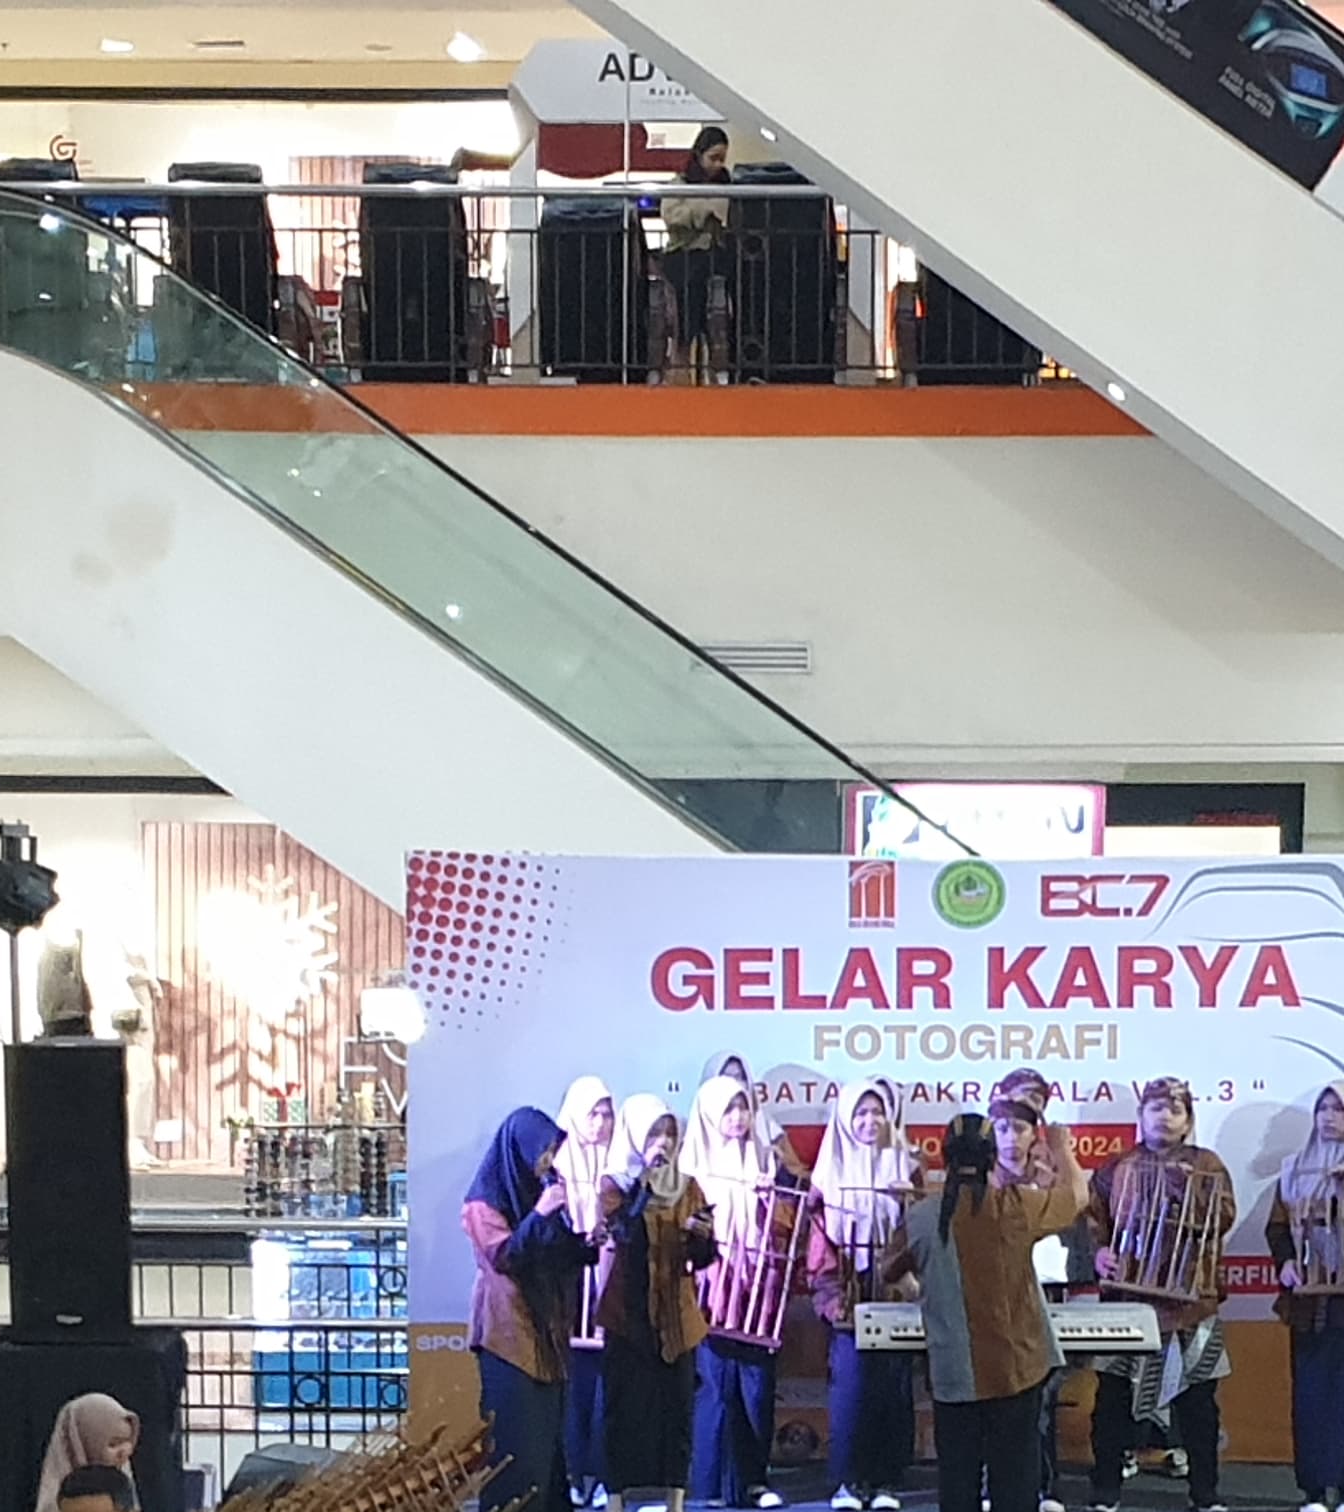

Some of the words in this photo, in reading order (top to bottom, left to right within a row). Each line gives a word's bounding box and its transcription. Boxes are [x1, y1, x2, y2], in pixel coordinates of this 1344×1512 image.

[598, 52, 672, 82] AD
[651, 946, 953, 1011] GELAR
[987, 945, 1302, 1009] KARYA
[812, 1023, 1119, 1062] FOTOGRAFI
